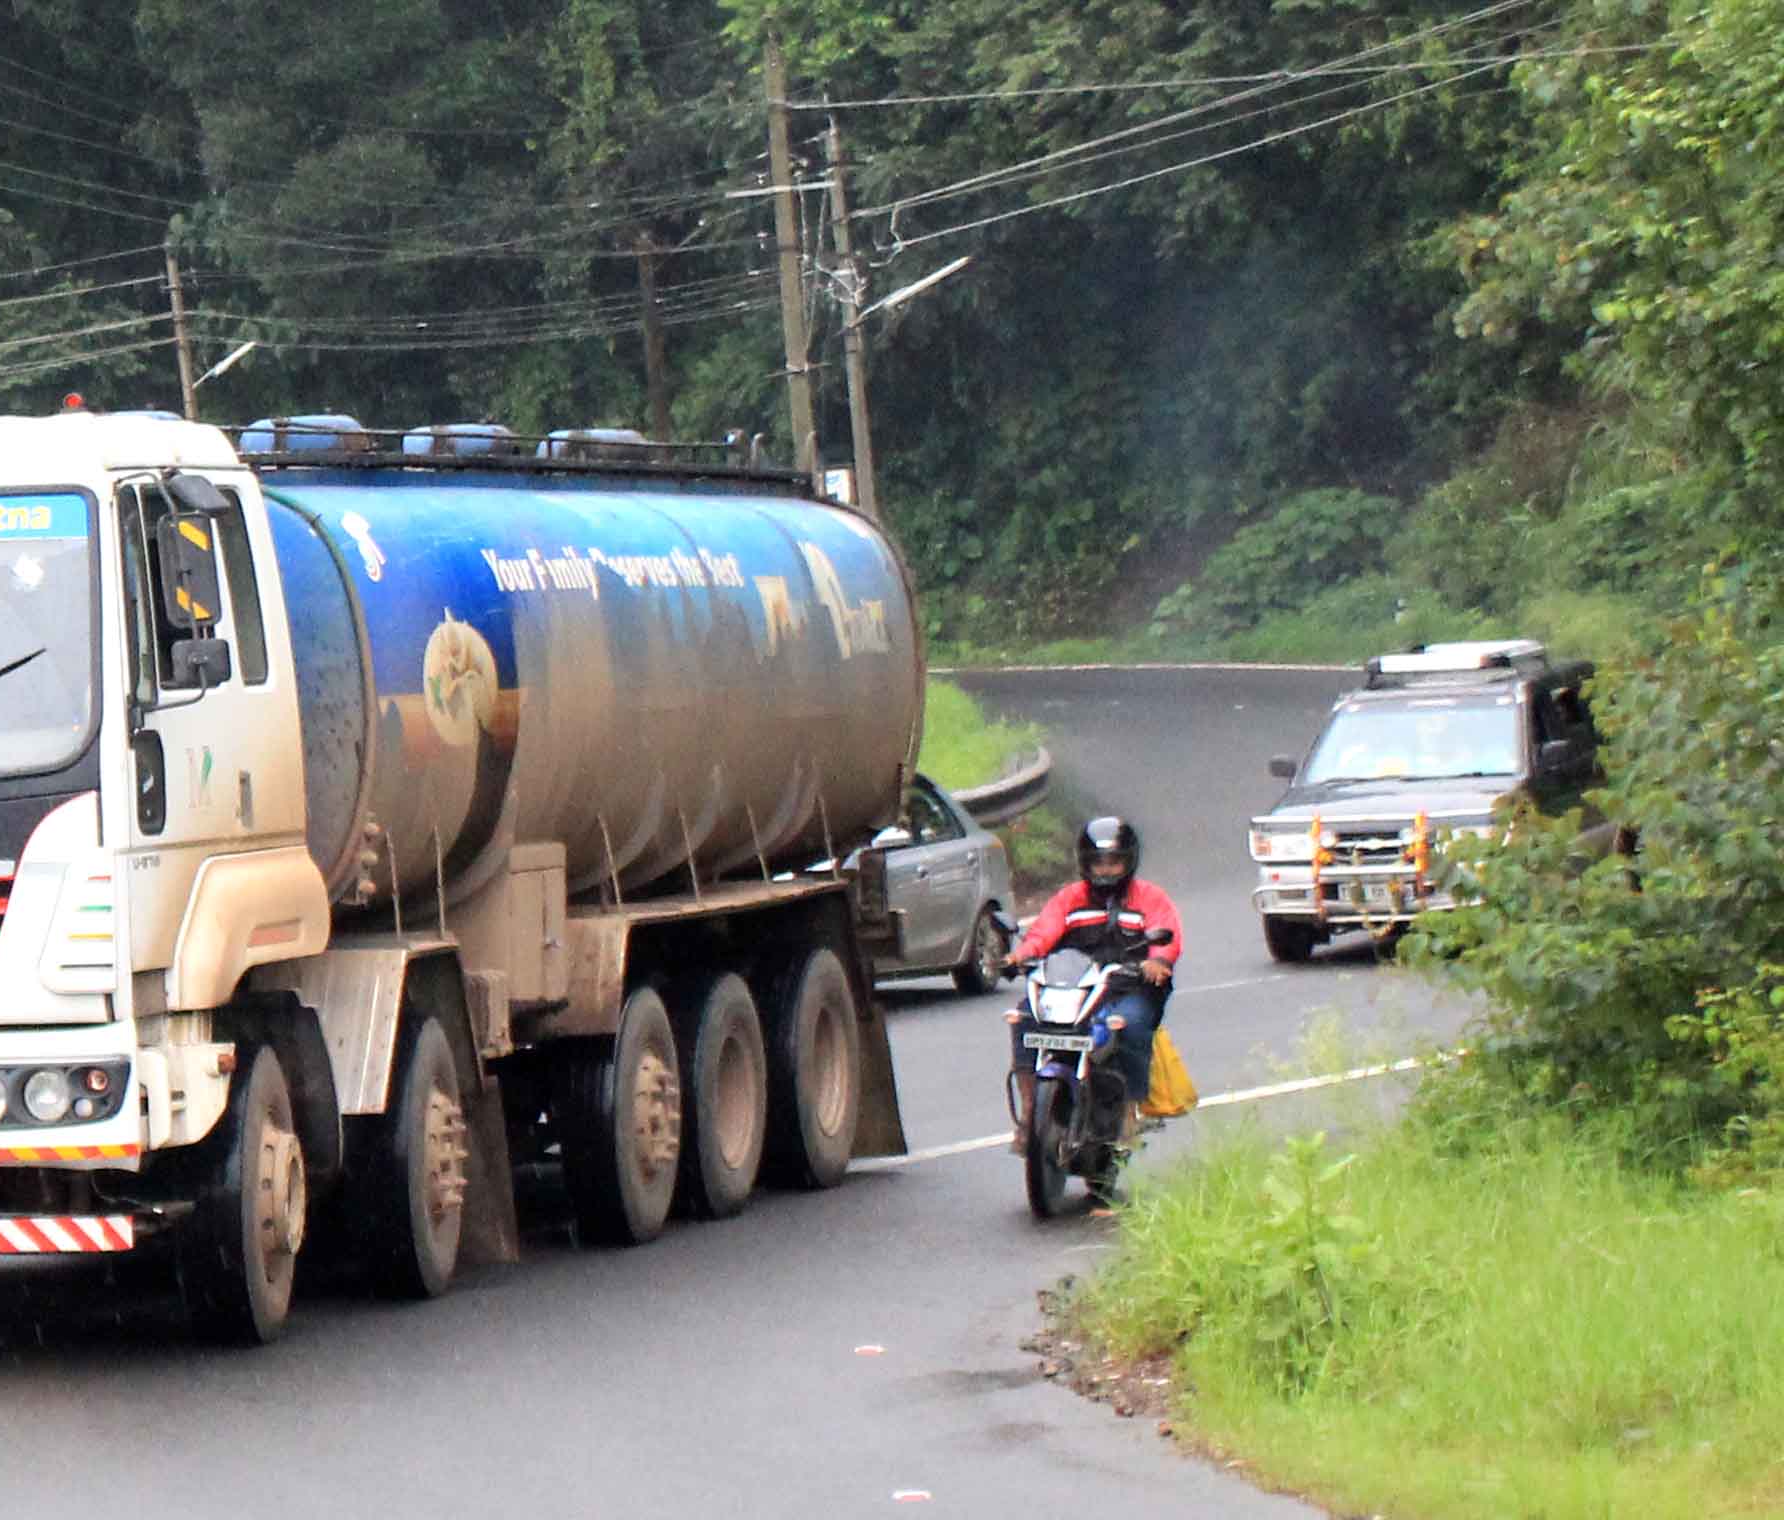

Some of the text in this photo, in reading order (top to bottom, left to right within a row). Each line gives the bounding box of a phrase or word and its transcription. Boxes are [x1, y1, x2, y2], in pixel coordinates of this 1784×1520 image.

[480, 549, 535, 592] Your
[526, 546, 599, 600] Fmily
[587, 547, 677, 587] Dserves
[669, 546, 712, 587] the
